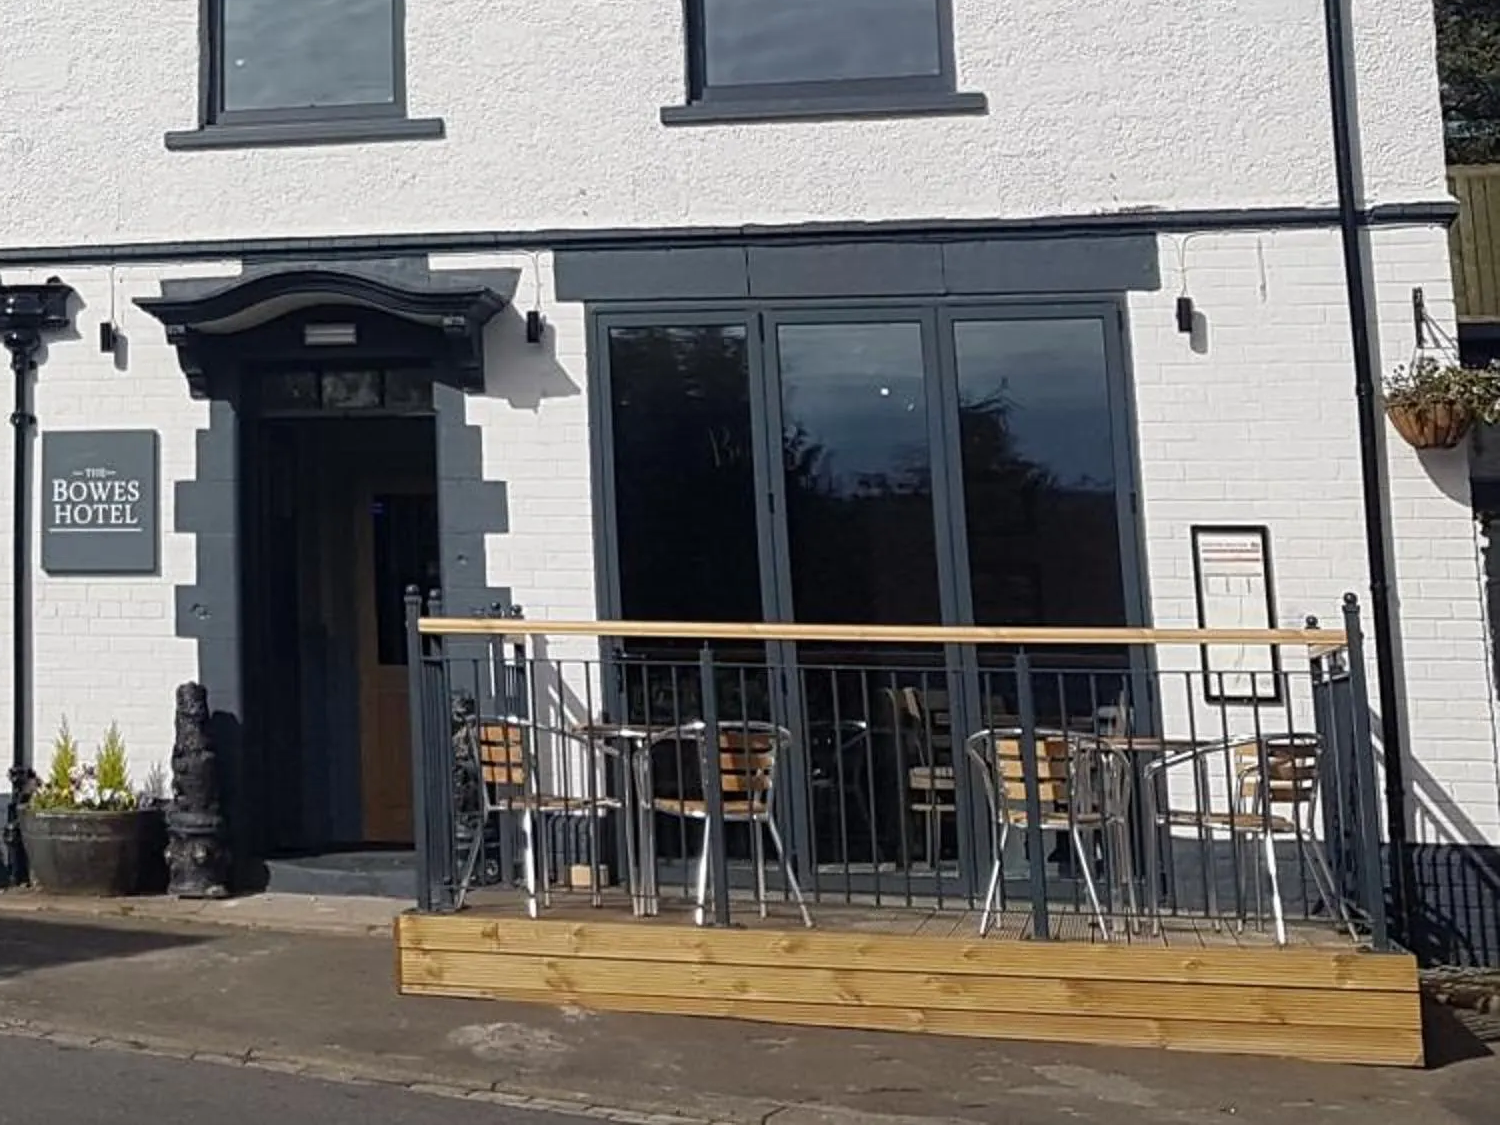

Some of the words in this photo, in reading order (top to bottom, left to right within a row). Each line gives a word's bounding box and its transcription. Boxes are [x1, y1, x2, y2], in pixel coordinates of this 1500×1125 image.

[84, 468, 106, 477] THE
[52, 479, 140, 502] BOWES
[54, 504, 138, 524] HOTEL
